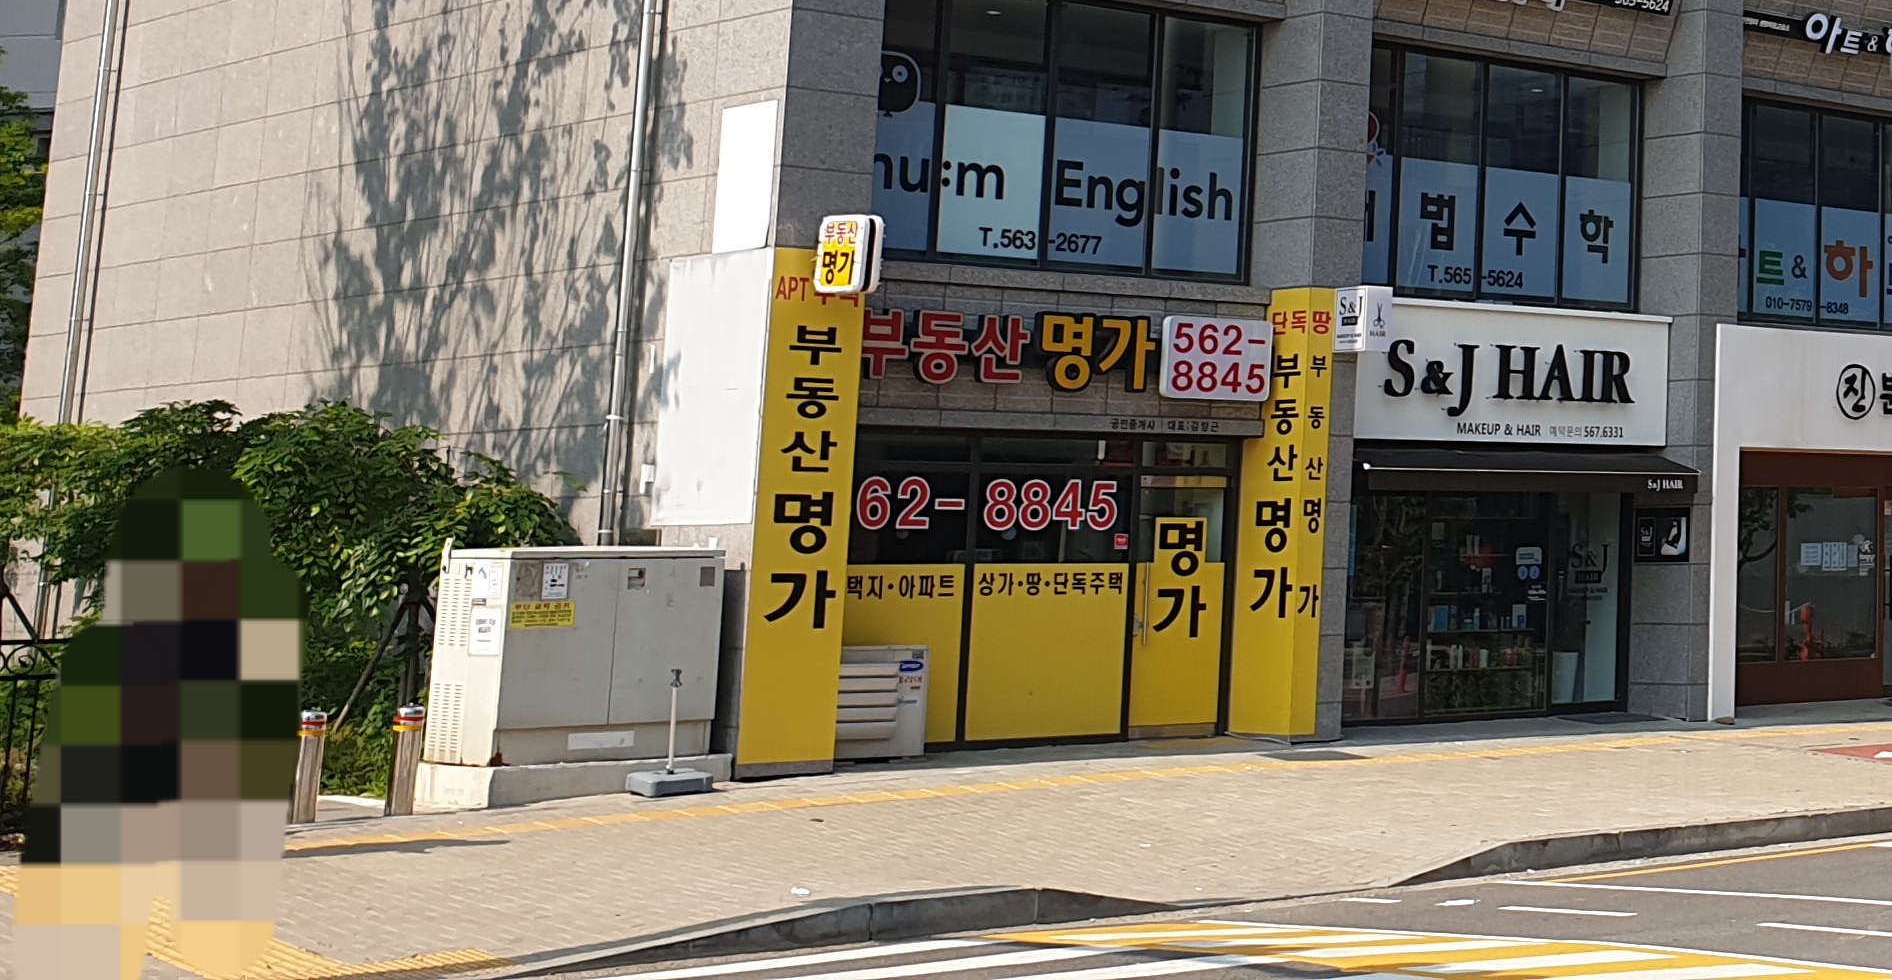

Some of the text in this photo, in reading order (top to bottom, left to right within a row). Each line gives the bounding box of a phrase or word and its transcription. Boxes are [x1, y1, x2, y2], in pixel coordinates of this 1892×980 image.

[1054, 159, 1233, 228] English
[823, 221, 858, 245] 부동산
[821, 250, 856, 285] 명가
[775, 275, 811, 303] APT
[1272, 309, 1308, 337] 단독
[1312, 310, 1332, 335] 땅
[1338, 295, 1364, 319] S&J
[861, 308, 1158, 393] 부동산 명가
[1172, 321, 1268, 357] 562-
[1170, 361, 1268, 395] 8845
[1383, 338, 1636, 418] S&J HAIR
[781, 324, 843, 474] 부동산
[1111, 418, 1156, 430] 공인중개사
[1456, 422, 1501, 436] MAKEUP
[1503, 423, 1514, 436] &
[1516, 423, 1542, 437] HAIR
[1583, 424, 1625, 439] 567.6331
[1662, 478, 1684, 490] HAIR
[764, 490, 837, 630] 명가
[1153, 520, 1208, 639] 명가
